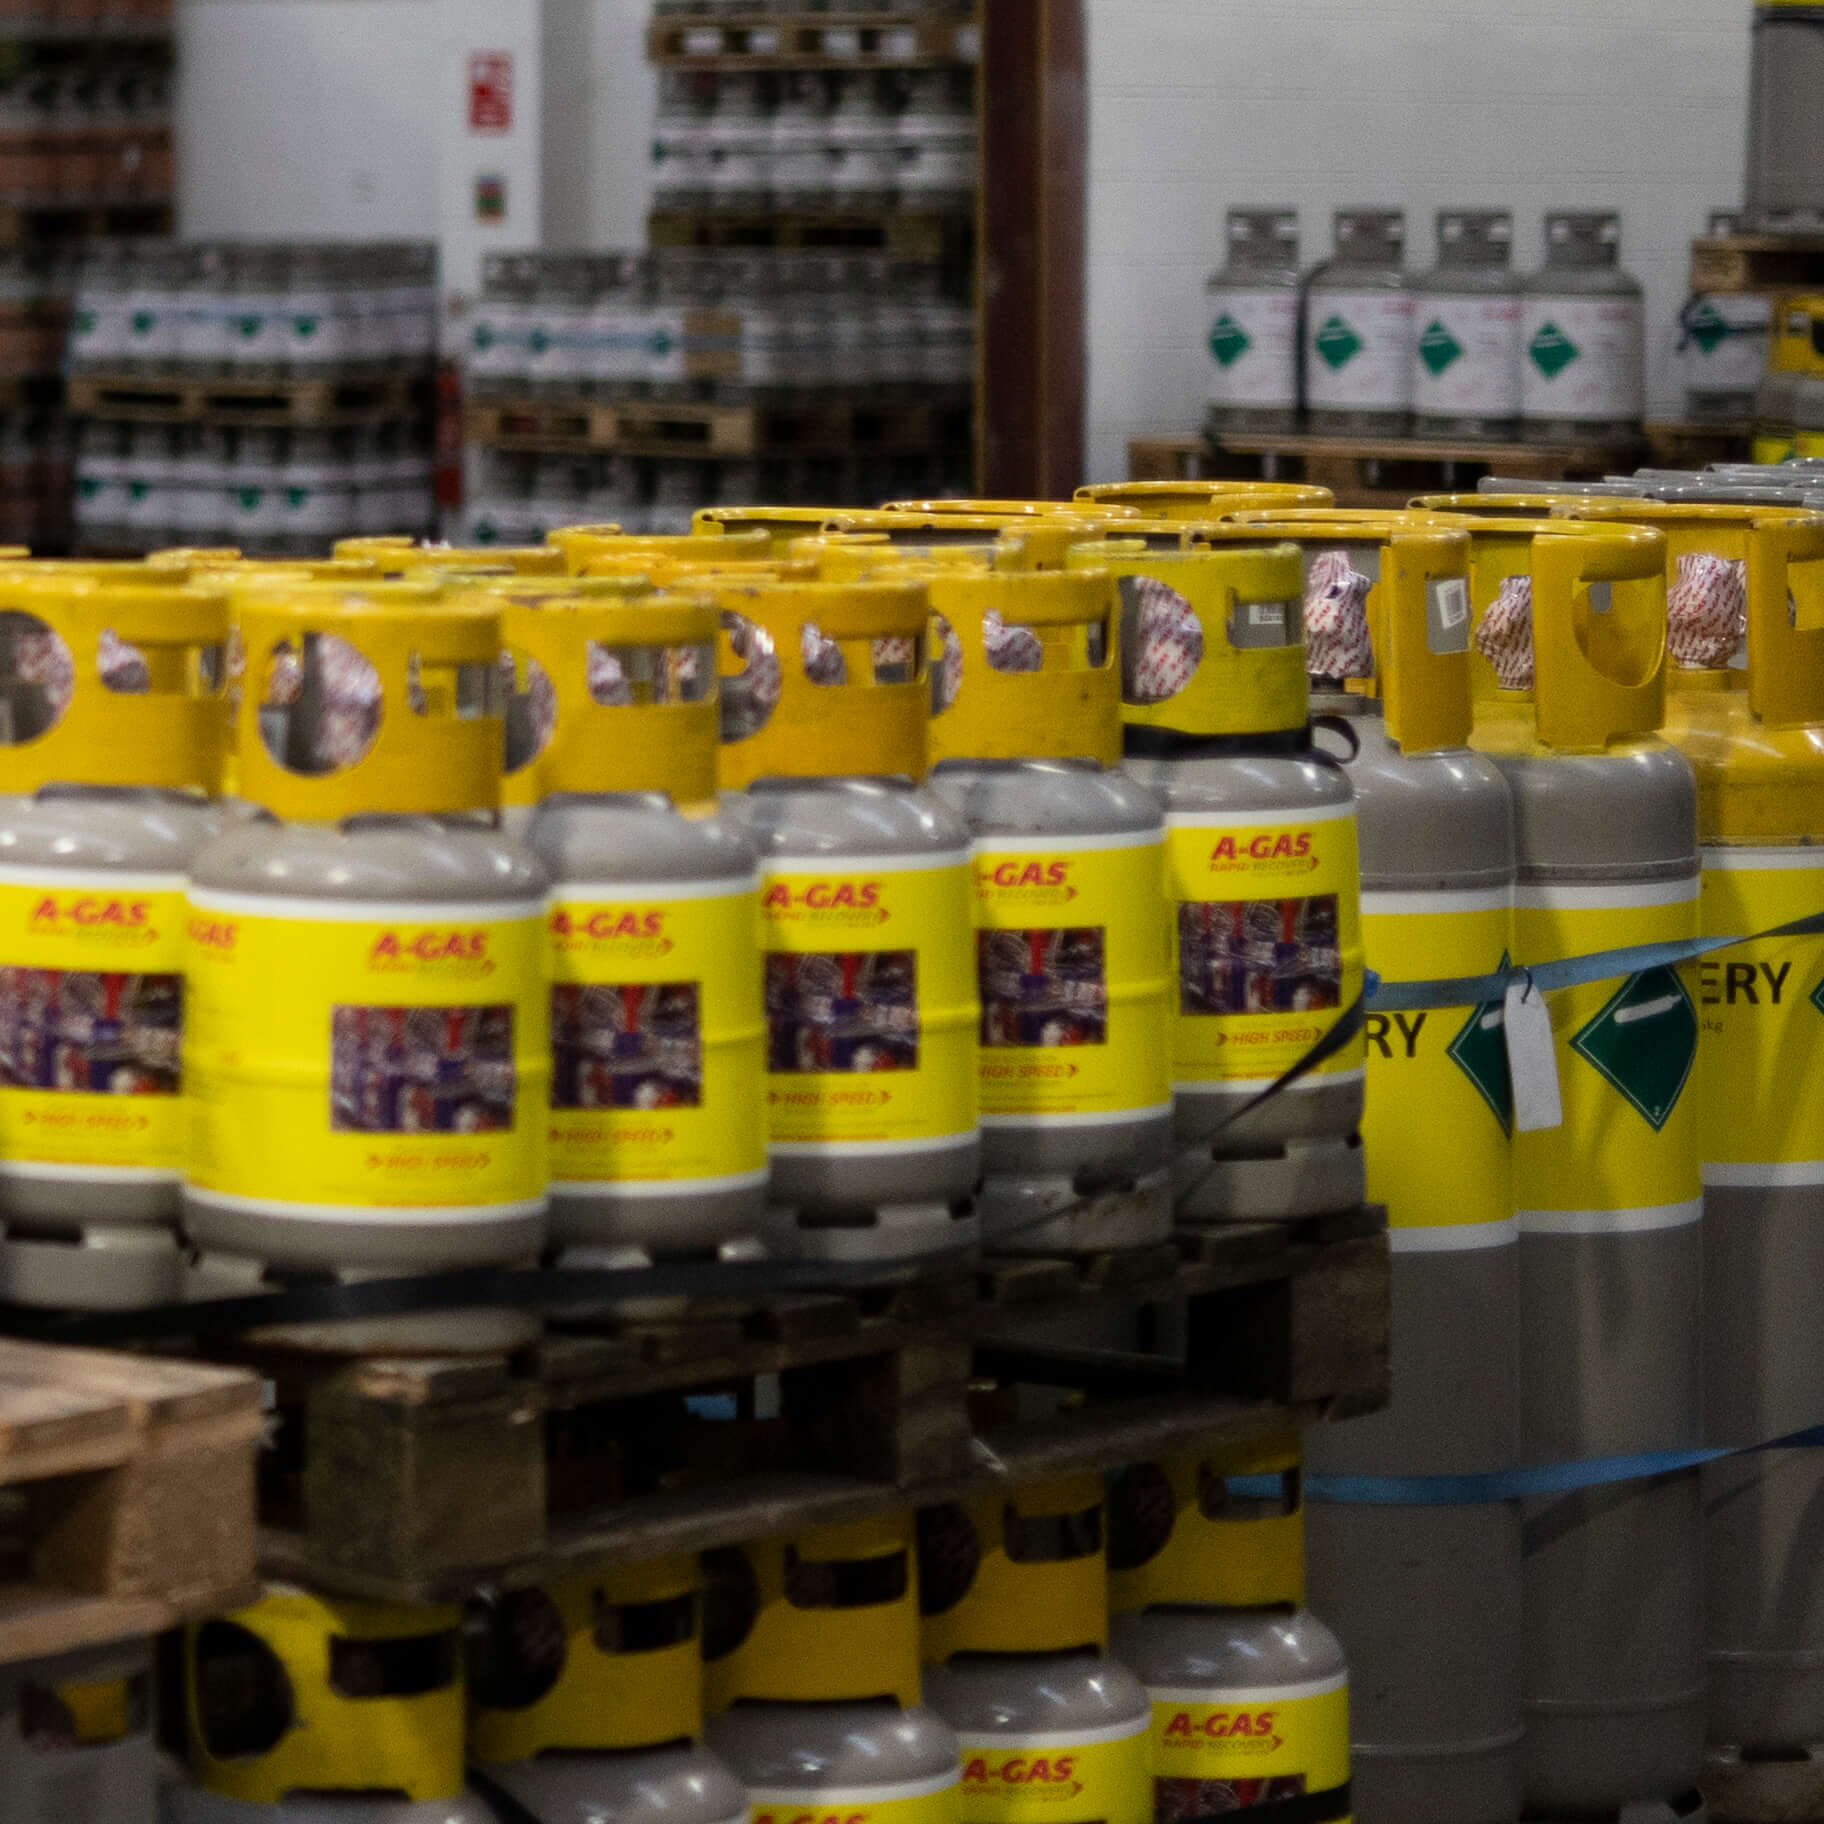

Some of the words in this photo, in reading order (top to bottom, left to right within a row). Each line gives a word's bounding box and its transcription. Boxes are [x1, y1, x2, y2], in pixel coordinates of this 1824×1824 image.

[1210, 832, 1313, 860] A-GAS
[763, 883, 882, 908] A-GAS
[34, 896, 151, 926] A-GAS
[549, 911, 665, 939] A-GAS
[371, 932, 489, 961] A-GAS
[1232, 1032, 1269, 1045] HIGH
[1273, 1029, 1312, 1043] SPEED
[1165, 1711, 1274, 1738] A-GAS
[962, 1758, 1074, 1783] A-GAS
